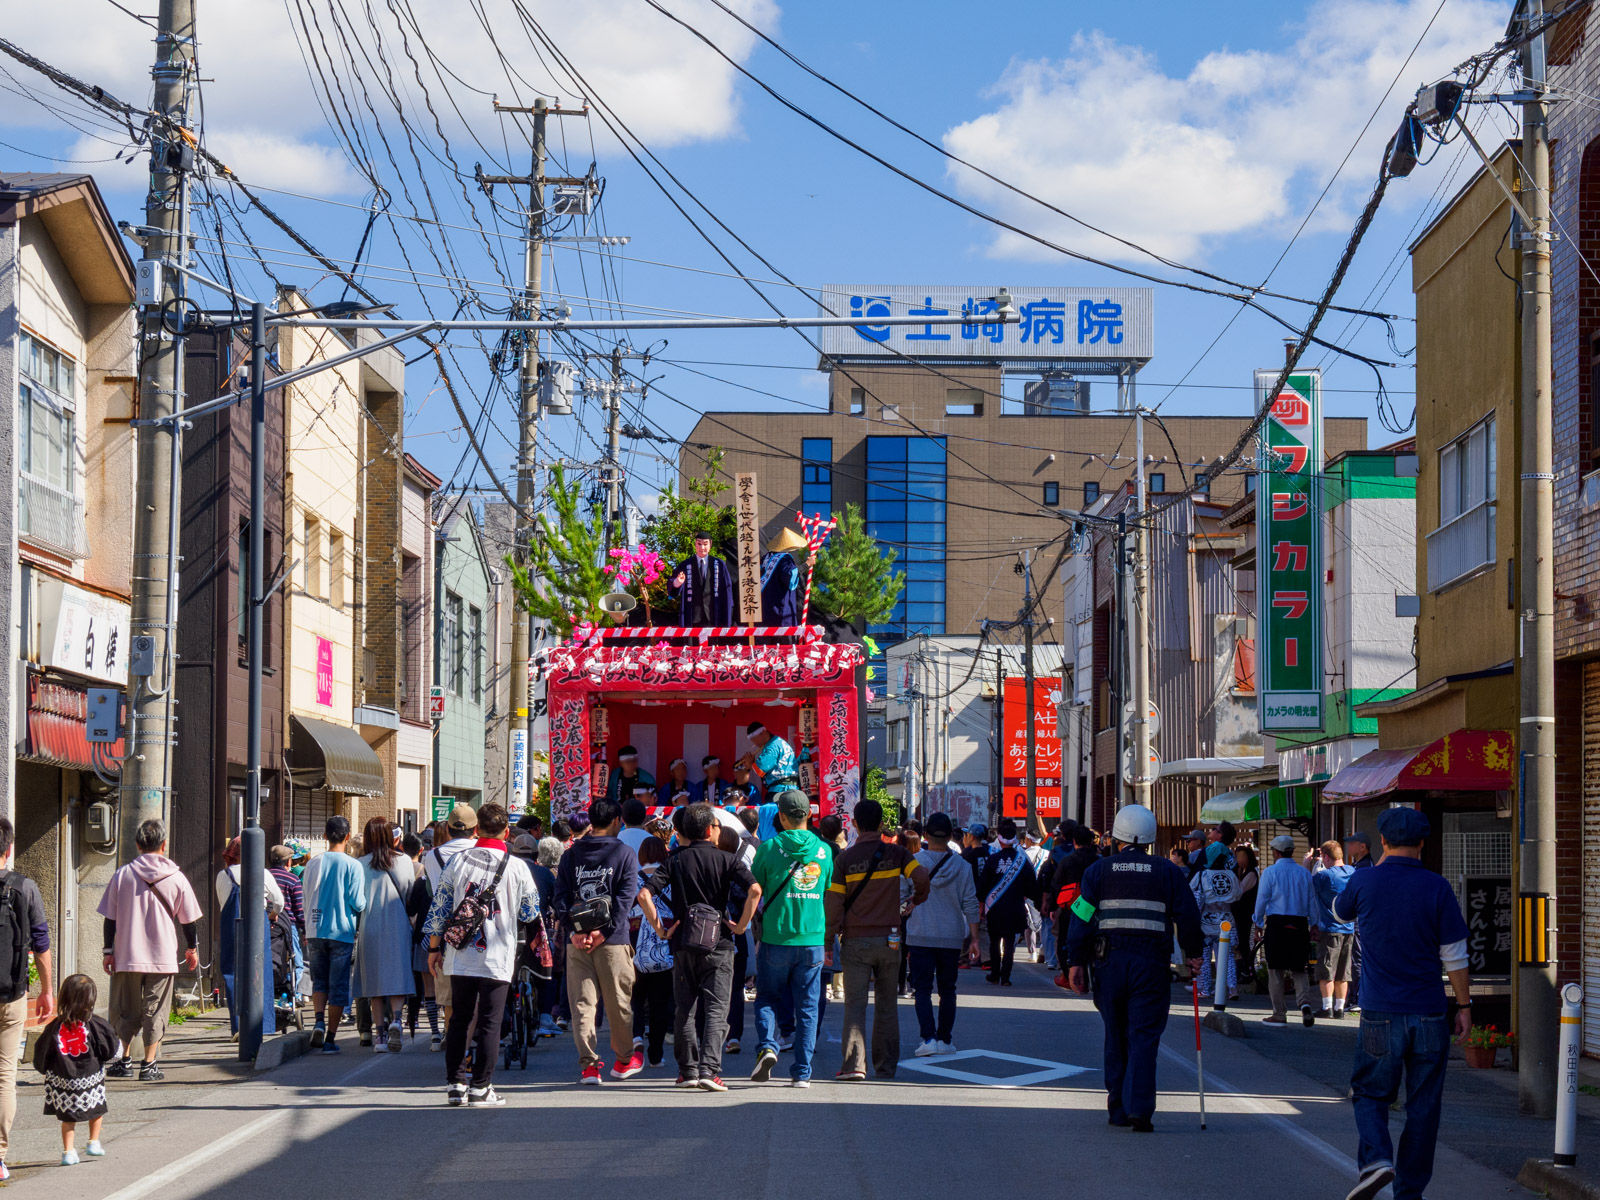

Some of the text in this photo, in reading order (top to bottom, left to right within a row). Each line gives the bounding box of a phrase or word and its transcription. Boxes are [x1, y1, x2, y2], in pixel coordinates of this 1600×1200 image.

[905, 296, 1124, 345] 土崎病院
[1271, 445, 1310, 668] フジカラー
[1034, 710, 1058, 725] AL
[1266, 705, 1319, 717] カメラの明光堂
[512, 731, 525, 790] 土崎駅前内科
[1013, 758, 1063, 772] クニッ
[848, 859, 895, 873] adias
[1111, 862, 1153, 873] 秋田県警察
[1469, 888, 1489, 971] さんとり
[1493, 885, 1512, 953] 居酒屋
[1566, 1043, 1579, 1084] 秋田市
